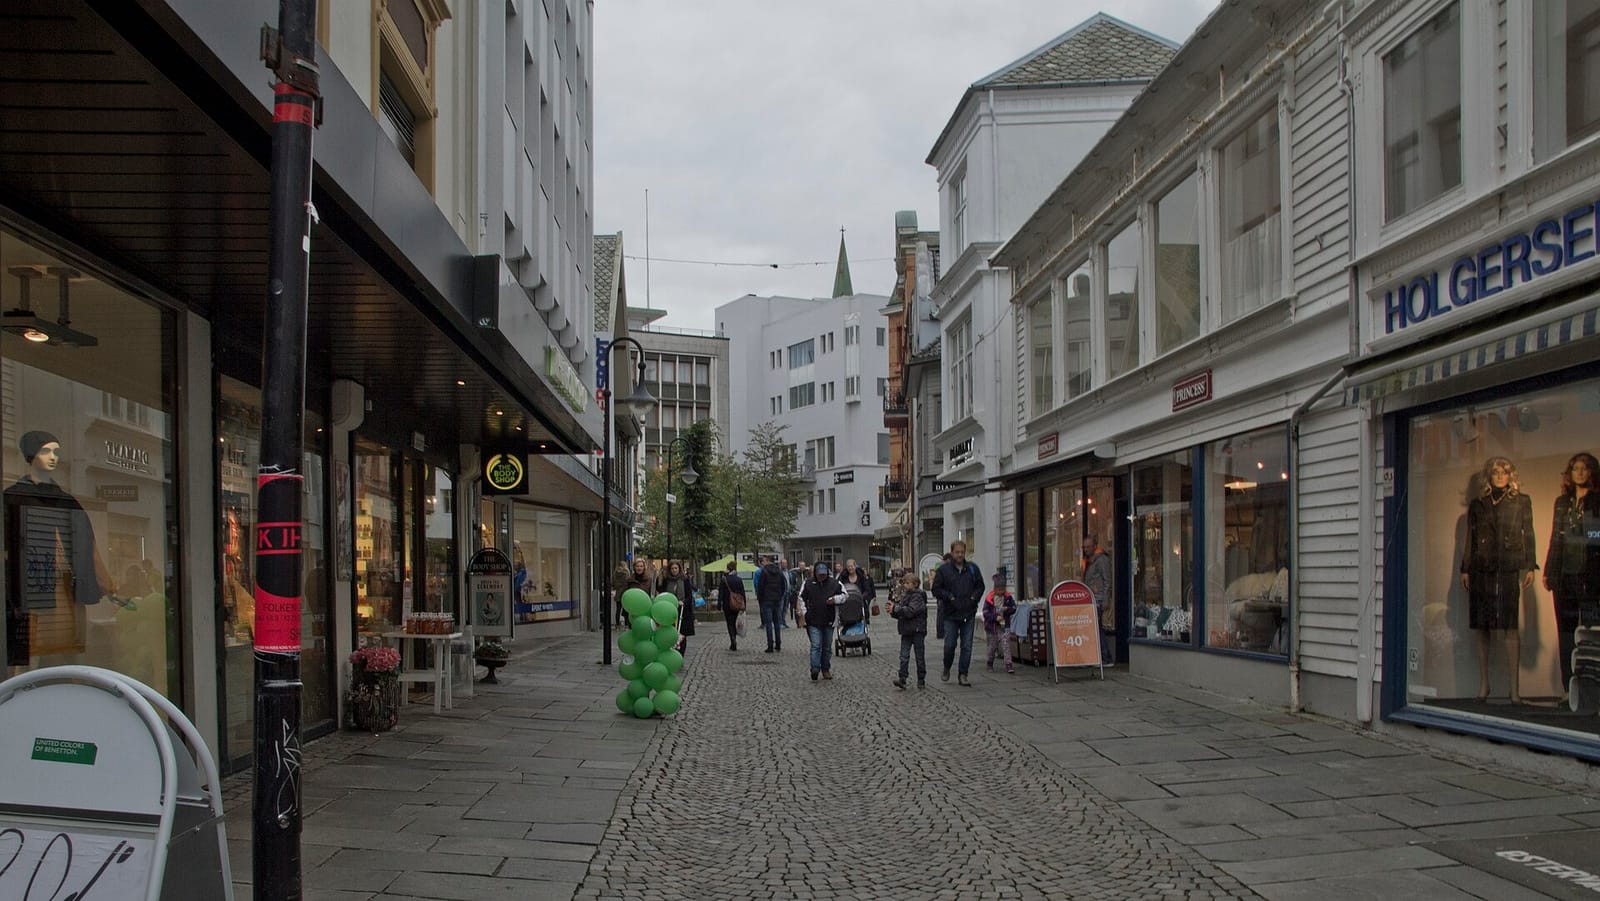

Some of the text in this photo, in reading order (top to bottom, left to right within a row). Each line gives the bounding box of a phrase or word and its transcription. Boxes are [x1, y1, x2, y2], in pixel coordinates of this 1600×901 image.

[1384, 200, 1600, 334] HOLGERSE
[1176, 380, 1206, 403] PRINCESS
[35, 739, 85, 749] UNITED COLORS
